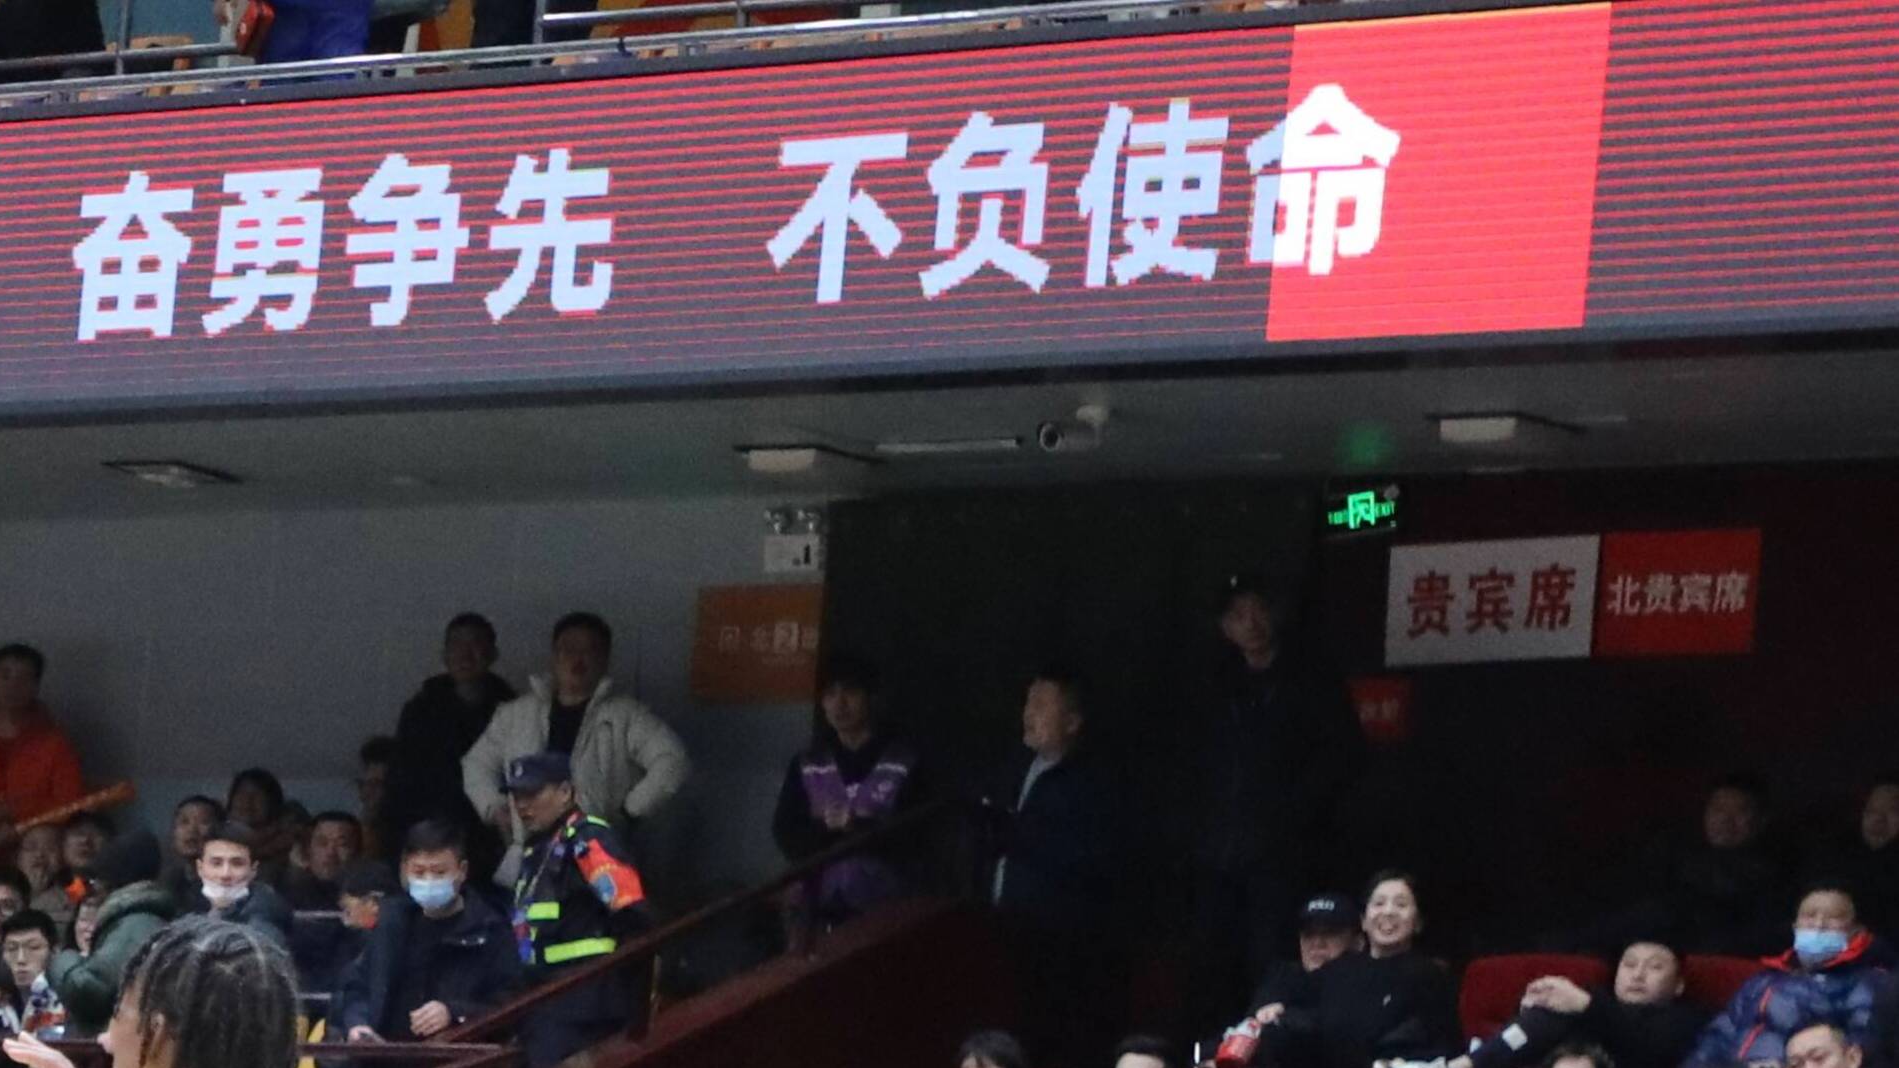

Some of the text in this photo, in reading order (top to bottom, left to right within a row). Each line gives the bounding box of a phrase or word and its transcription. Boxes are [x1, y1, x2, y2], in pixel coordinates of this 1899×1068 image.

[72, 148, 614, 342] 奋勇争先
[767, 83, 1401, 305] 不负使命
[1406, 562, 1577, 639] 贵宾席
[1606, 570, 1749, 617] 北贵宾席
